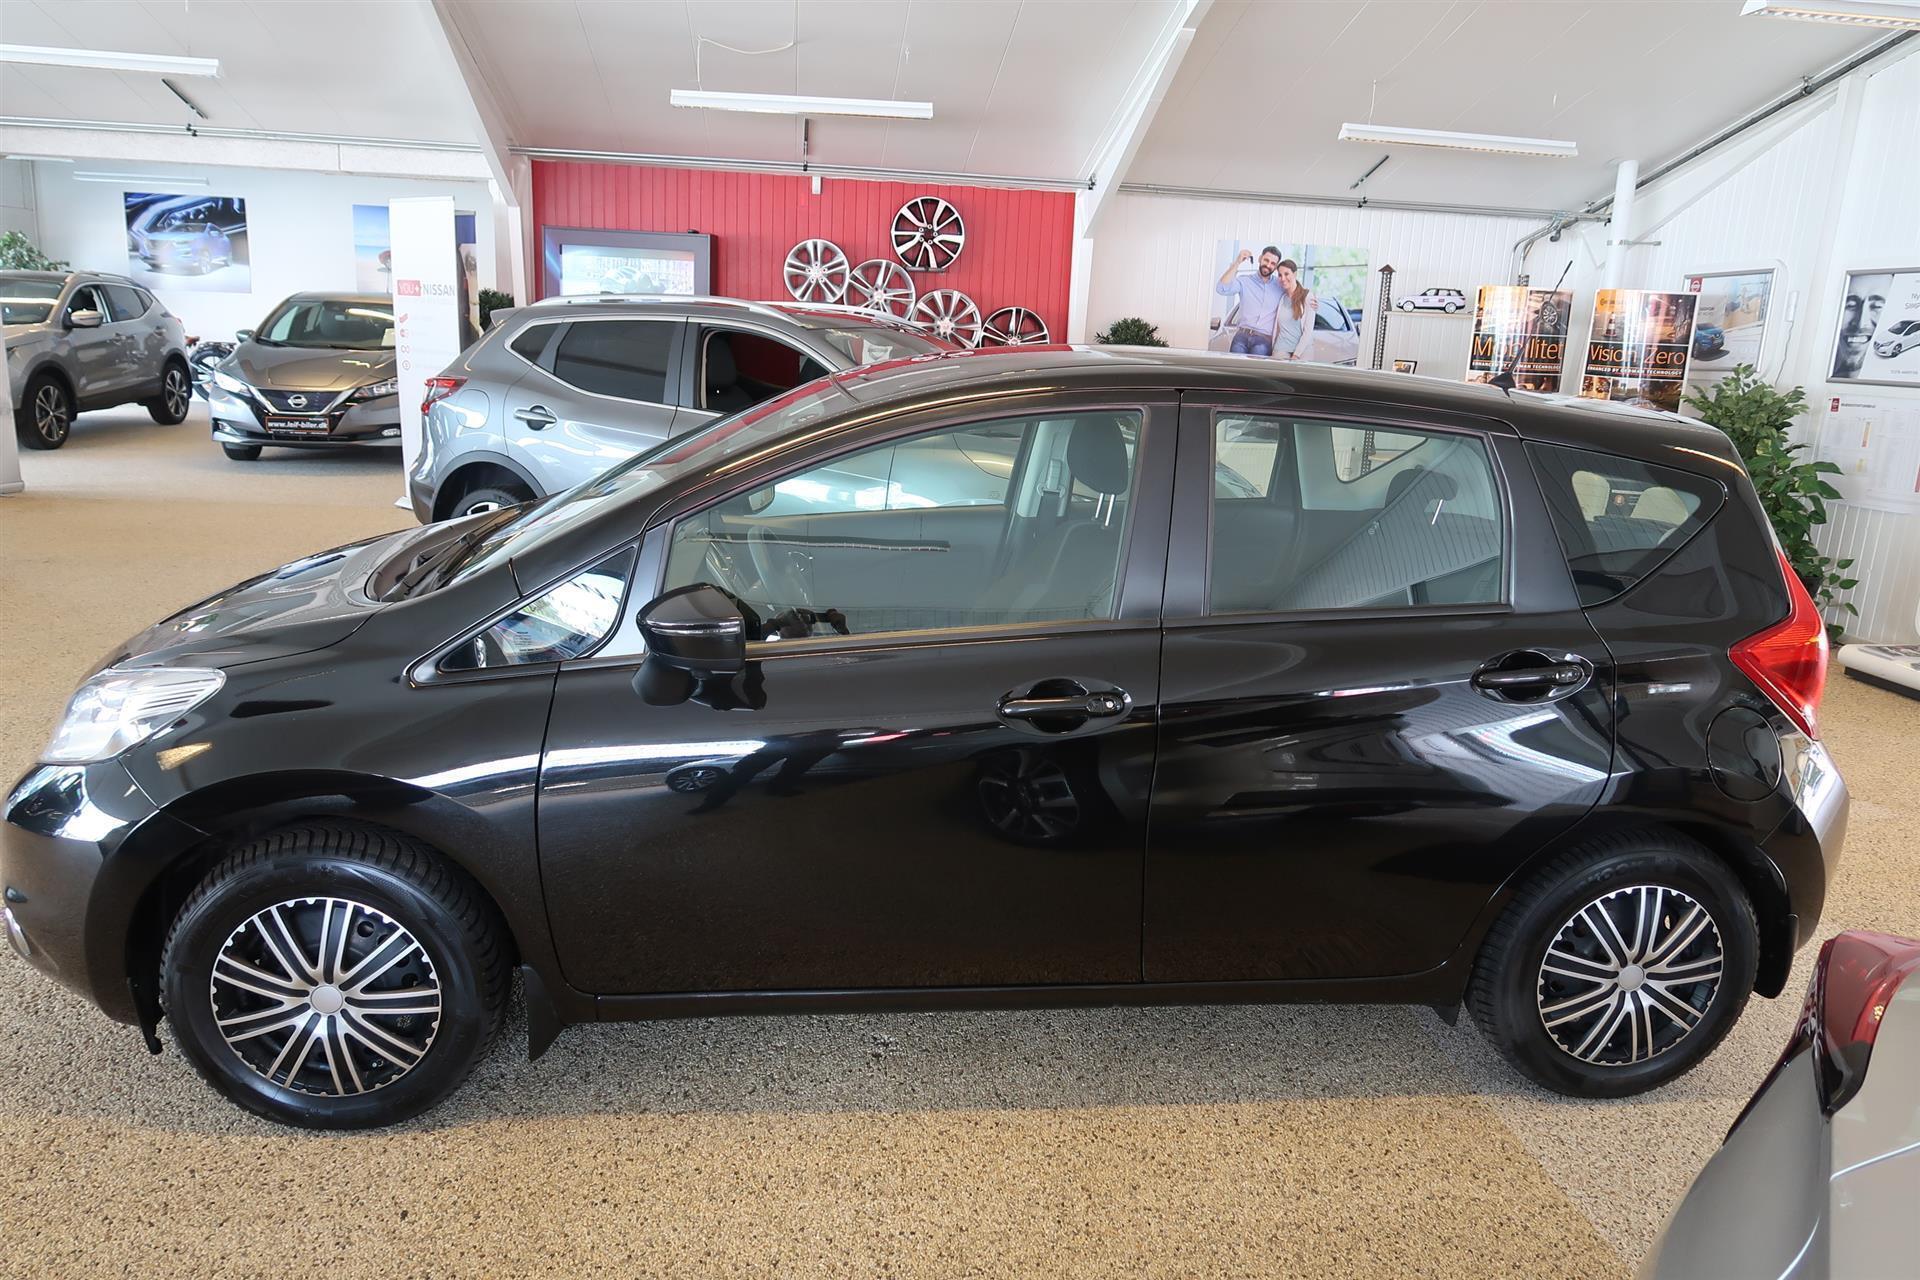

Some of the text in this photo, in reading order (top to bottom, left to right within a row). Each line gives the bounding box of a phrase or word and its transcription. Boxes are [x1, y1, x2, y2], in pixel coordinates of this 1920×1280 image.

[423, 283, 456, 297] NISSAN
[1473, 335, 1564, 360] Mobilitet
[1590, 344, 1685, 365] Vision Zero
